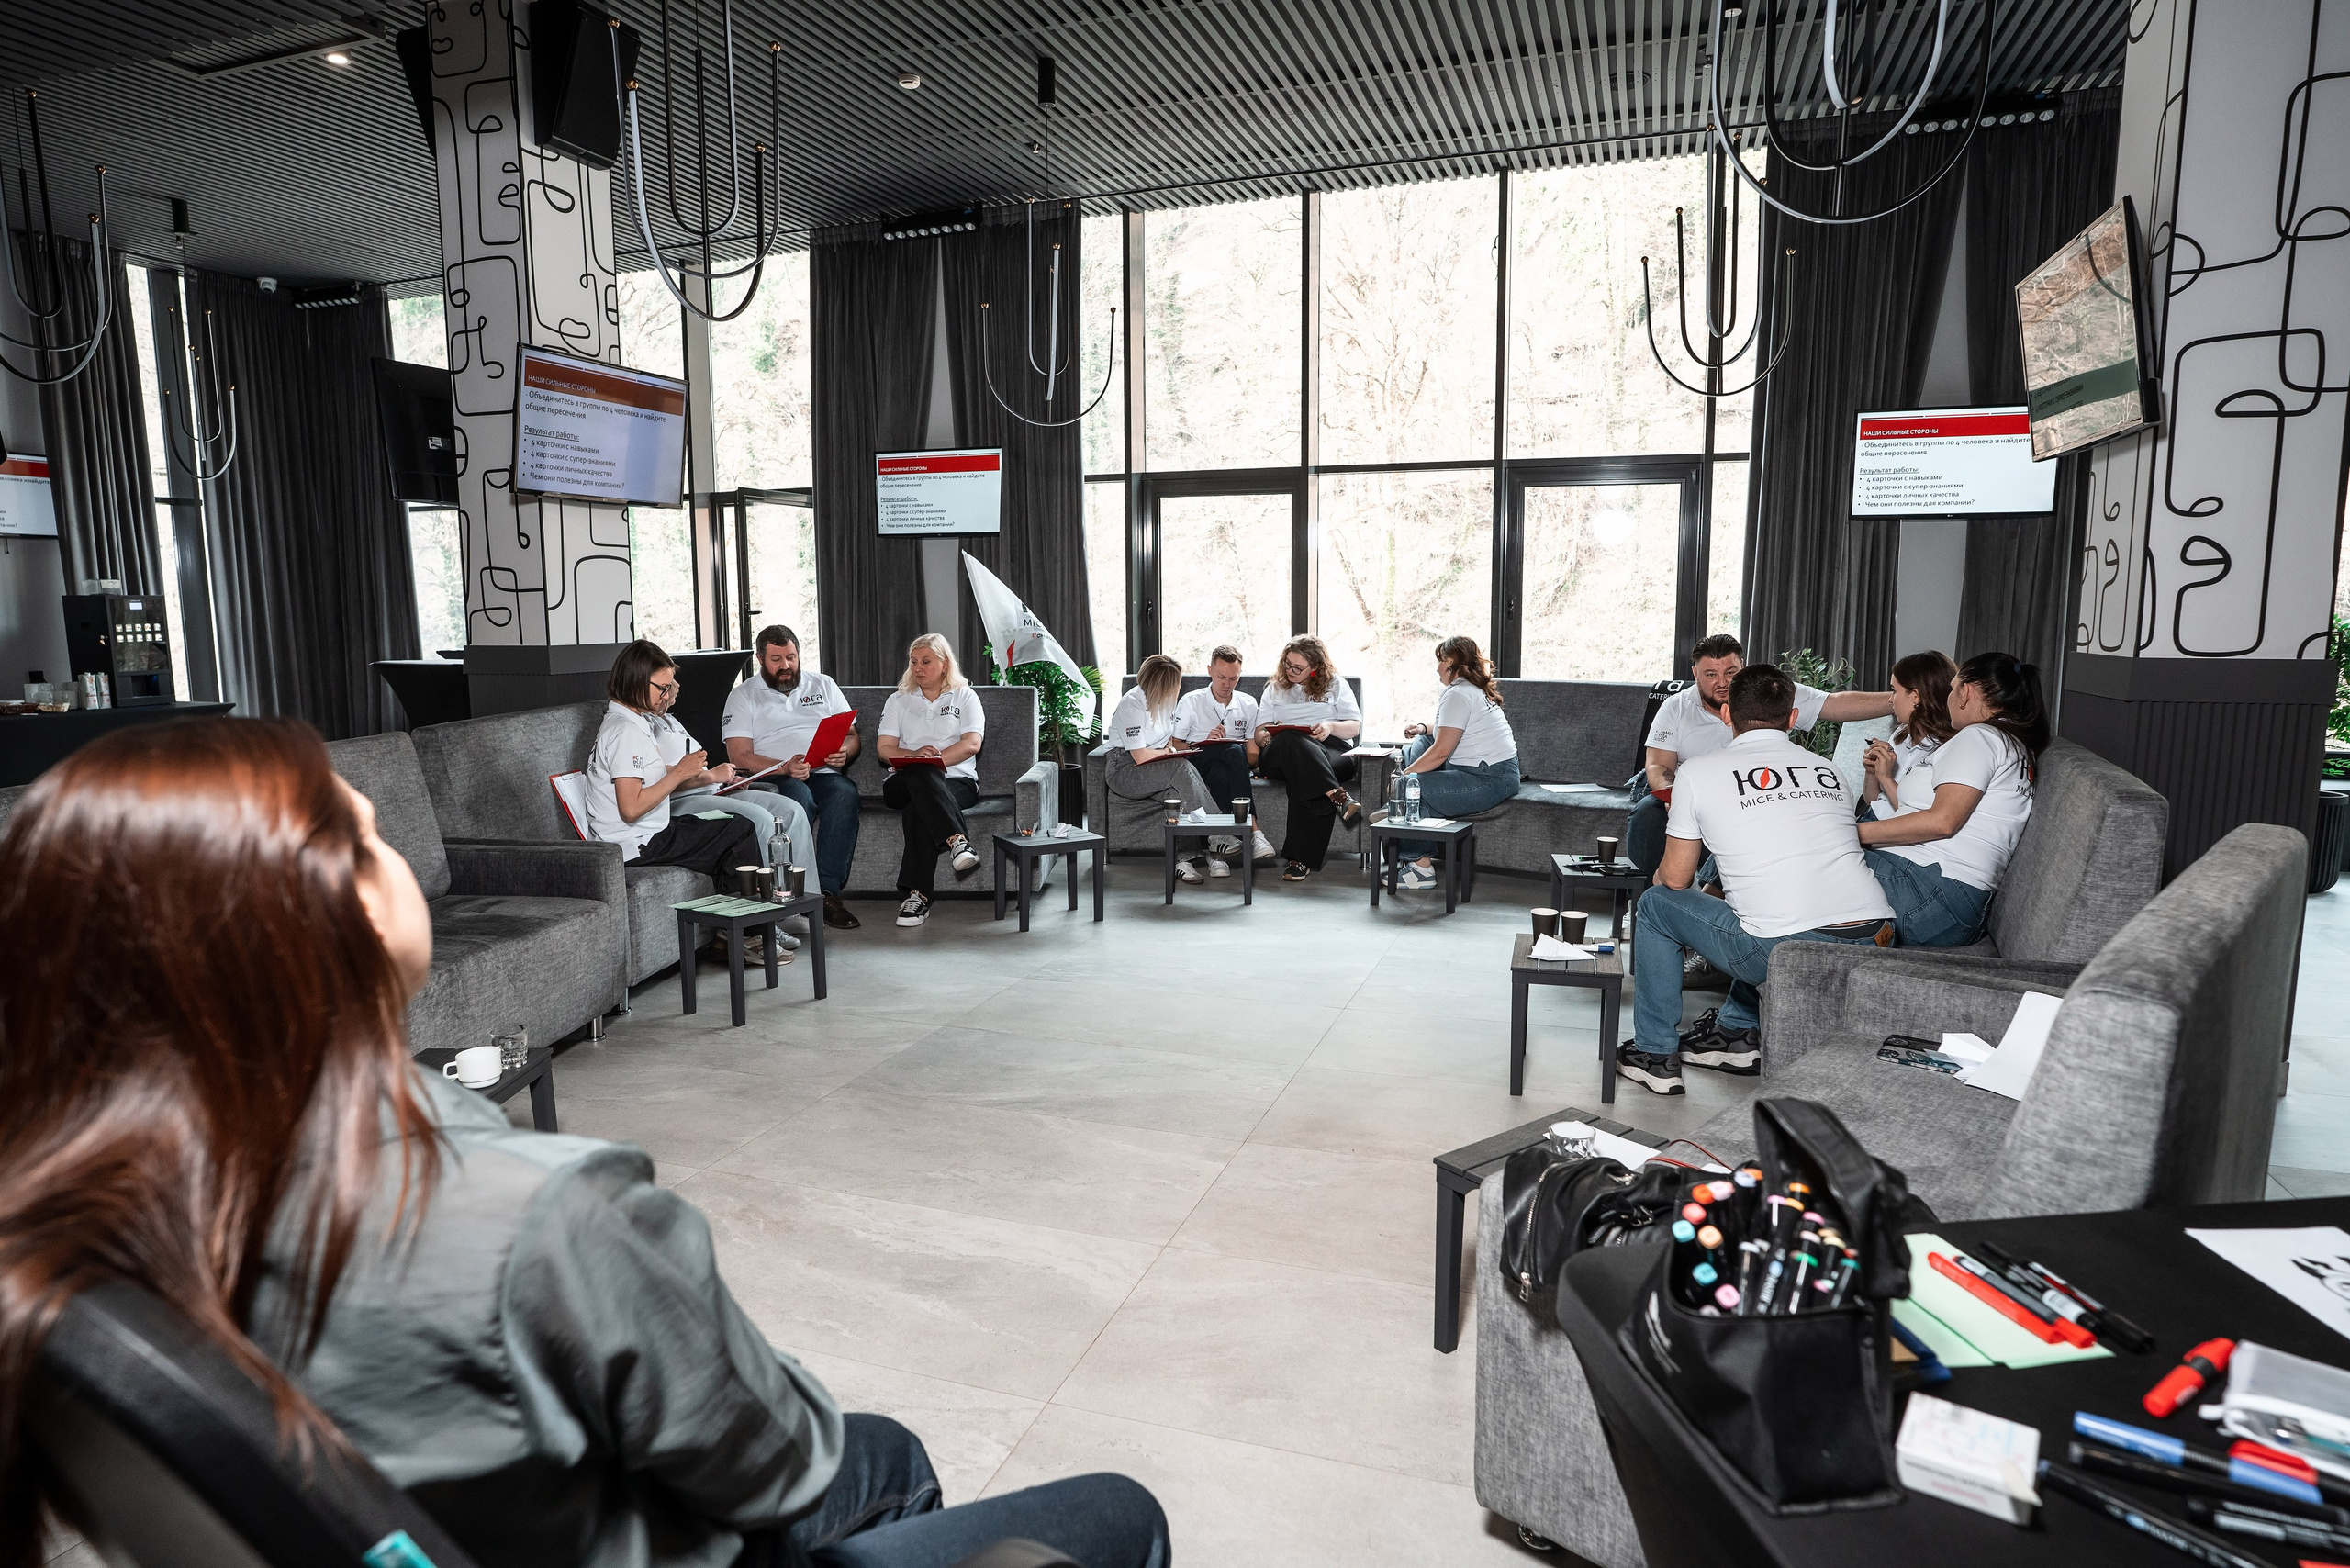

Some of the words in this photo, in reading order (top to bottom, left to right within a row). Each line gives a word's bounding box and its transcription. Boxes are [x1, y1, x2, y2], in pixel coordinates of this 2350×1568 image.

[528, 375, 545, 384] НАШИ
[545, 378, 571, 389] СИЛЬНЫЕ
[571, 383, 597, 394] СТОРОНЫ
[525, 402, 546, 412] общие
[547, 407, 586, 419] пересечения
[529, 390, 574, 406] Объединитесь
[580, 401, 600, 410] группы
[614, 408, 639, 418] человека
[644, 413, 666, 422] найдите
[524, 424, 555, 436] Результат
[555, 431, 580, 441] работы:
[536, 440, 565, 449] карточки
[570, 444, 599, 454] навыками
[536, 451, 565, 460] карточки
[569, 455, 616, 466] супер-знаниями
[535, 463, 564, 471] карточки
[565, 466, 588, 475] личных
[588, 469, 613, 477] качества
[530, 472, 543, 480] Чем
[556, 476, 582, 485] полезны
[594, 481, 625, 489] компании?
[1740, 794, 1774, 810] MICE
[1777, 792, 1787, 801] &
[1789, 790, 1844, 802] CATERING
